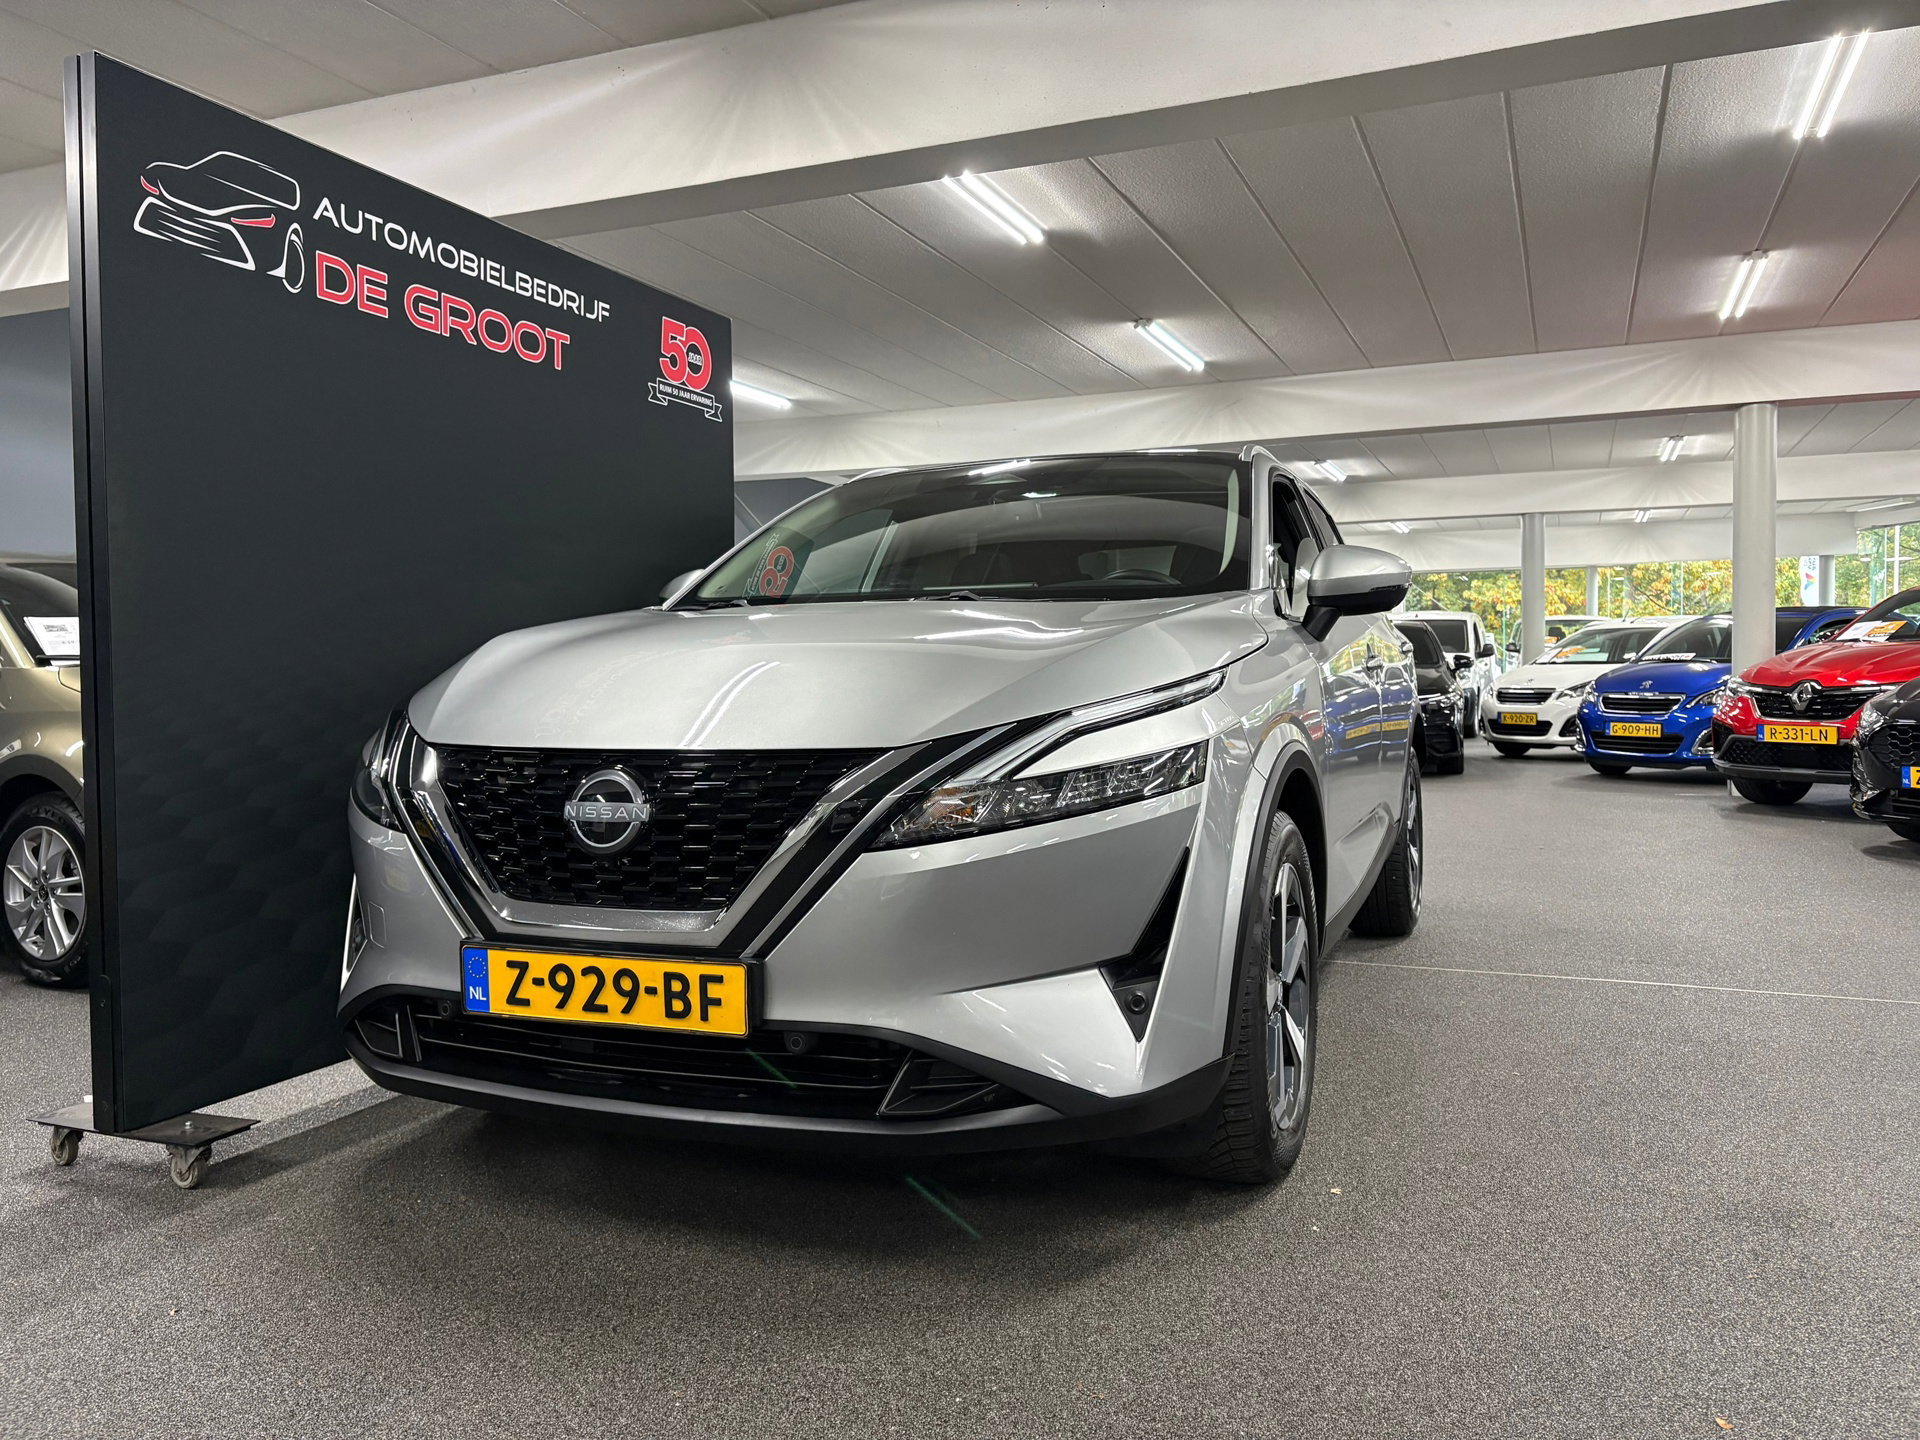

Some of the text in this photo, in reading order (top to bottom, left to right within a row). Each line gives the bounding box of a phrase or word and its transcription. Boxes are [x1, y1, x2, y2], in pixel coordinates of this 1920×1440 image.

[313, 196, 611, 322] AUTOMOBIELBEDRIJF
[315, 250, 570, 370] DE GROOT
[660, 316, 712, 391] 50
[659, 383, 713, 407] RUIM 50 JAAR ERVARING
[1503, 713, 1535, 724] K-920-ZR
[1612, 724, 1659, 736] G-909-HH
[1770, 727, 1828, 742] R-331-LN
[565, 804, 648, 821] NISSAN
[468, 959, 724, 1022] NL Z-929-BF
